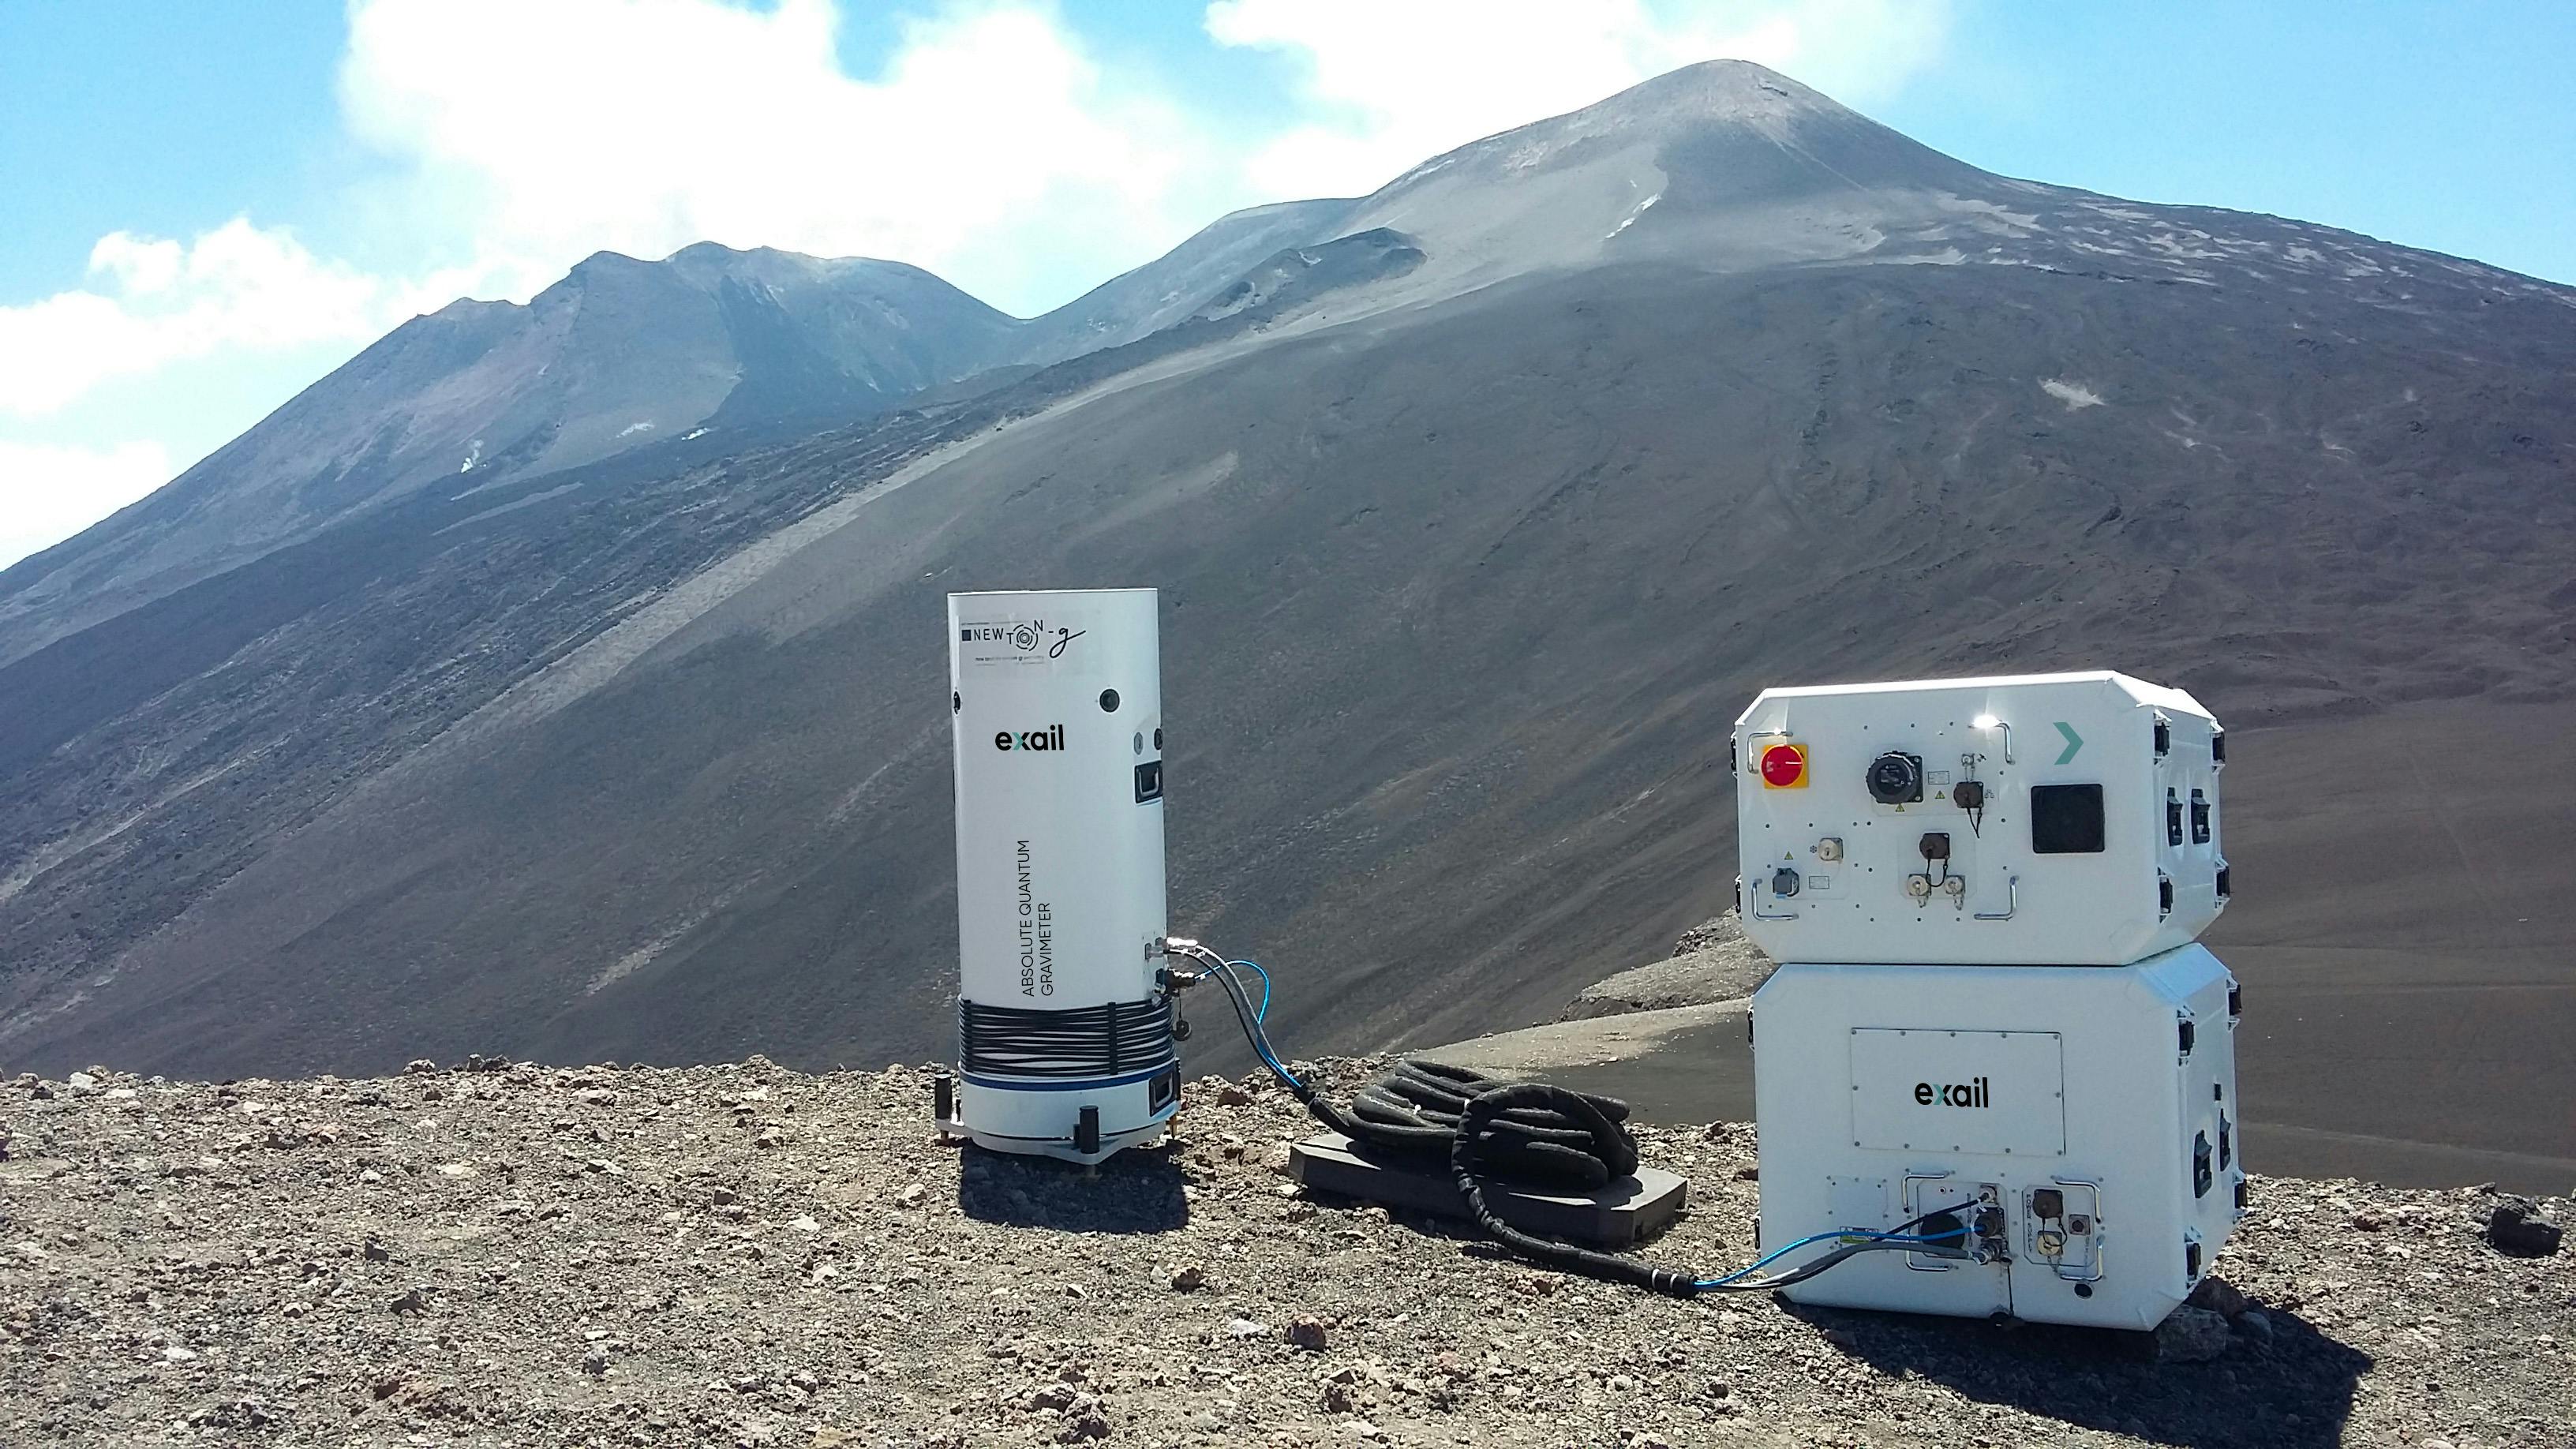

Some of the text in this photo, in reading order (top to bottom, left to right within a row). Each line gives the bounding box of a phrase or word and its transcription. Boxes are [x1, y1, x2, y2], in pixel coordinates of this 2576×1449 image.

[994, 724, 1065, 751] exail
[1017, 841, 1035, 997] ABSOLUTE QUANTUM
[1038, 902, 1054, 996] GRAVIMETER
[1915, 1076, 1988, 1108] exail
